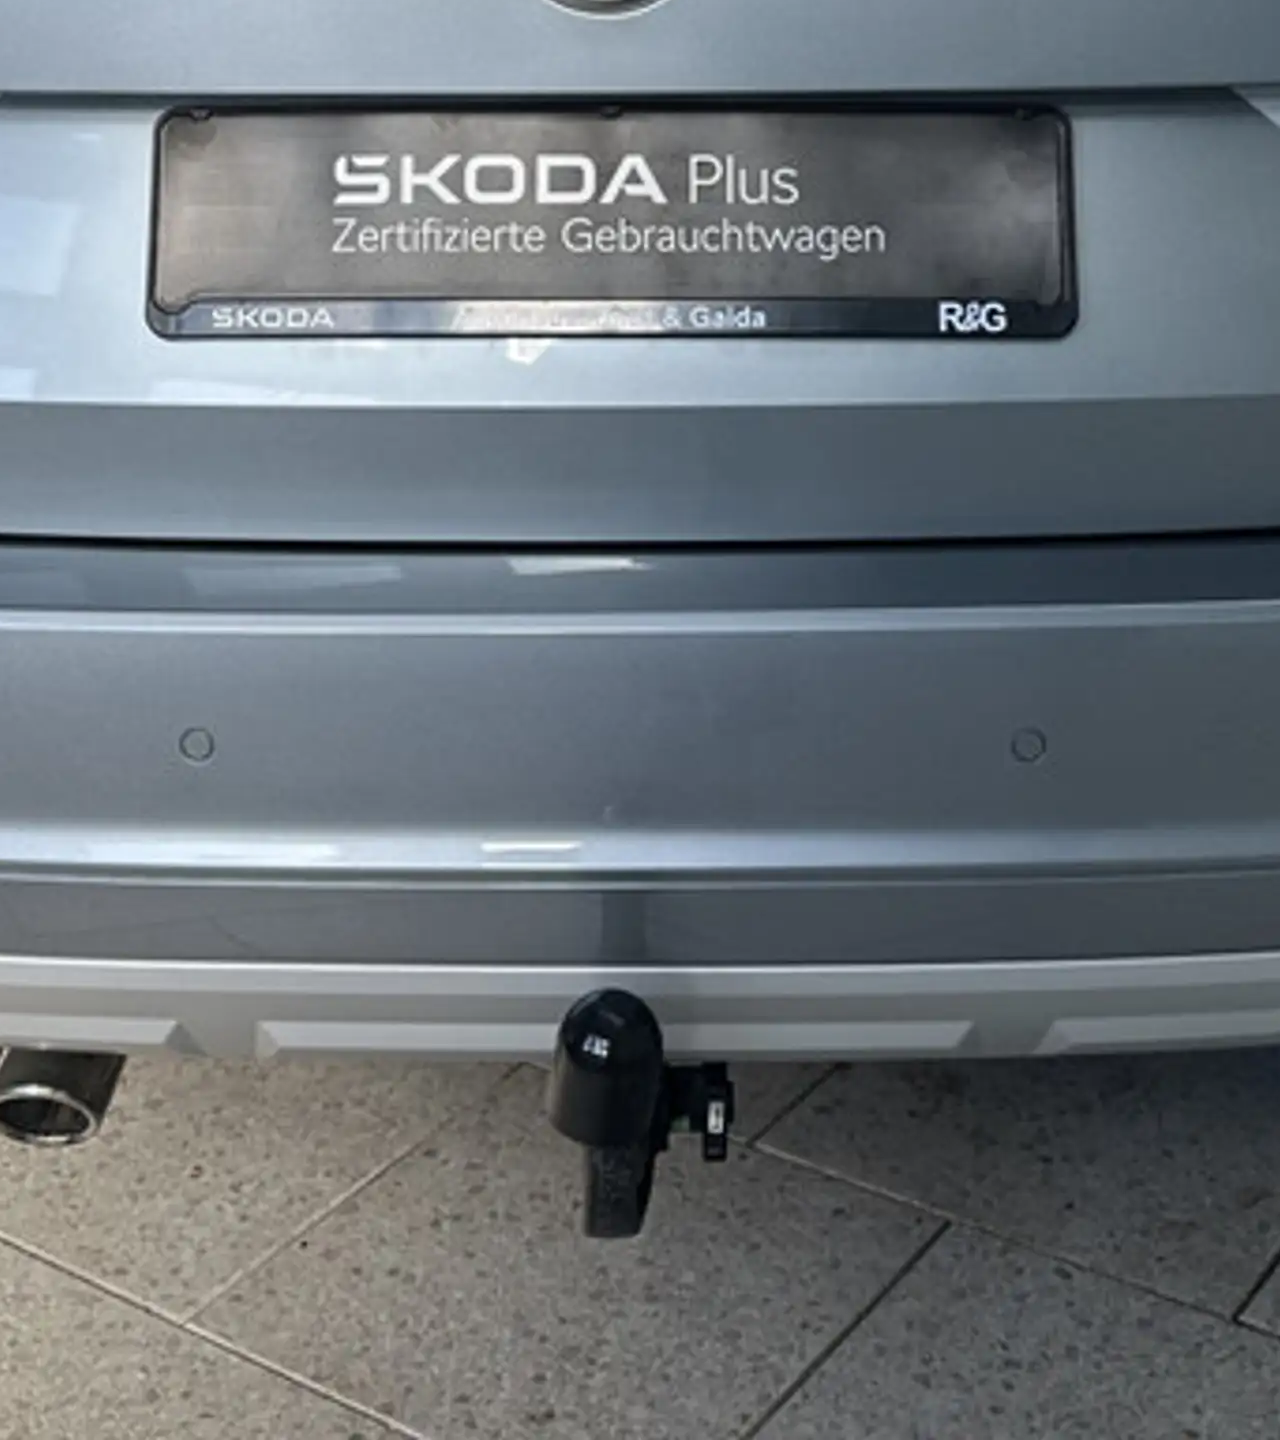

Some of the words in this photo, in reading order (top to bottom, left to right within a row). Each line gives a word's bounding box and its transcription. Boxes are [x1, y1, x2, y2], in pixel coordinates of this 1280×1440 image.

[333, 152, 669, 206] SKODA
[688, 153, 800, 206] Plus
[331, 216, 547, 254] Zertifizierte
[560, 216, 886, 262] Gebrauchtwagen
[938, 301, 1008, 333] R&G
